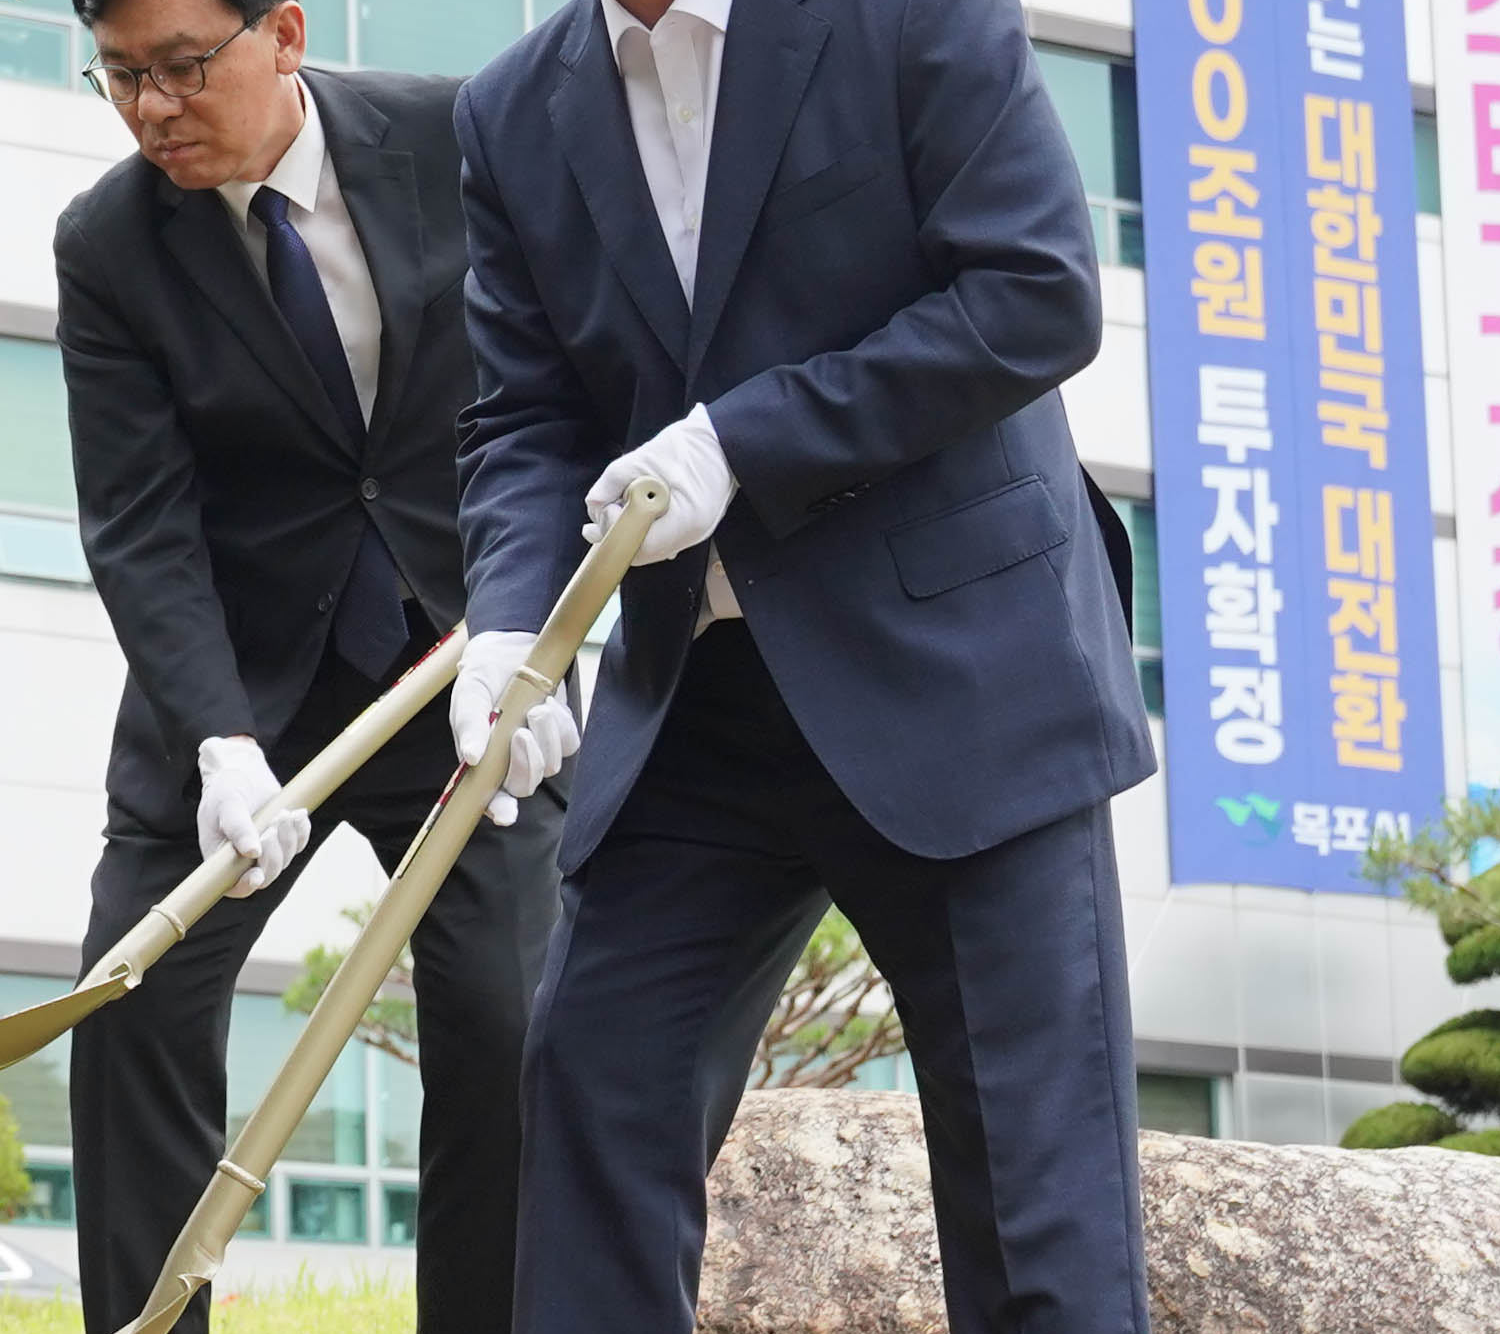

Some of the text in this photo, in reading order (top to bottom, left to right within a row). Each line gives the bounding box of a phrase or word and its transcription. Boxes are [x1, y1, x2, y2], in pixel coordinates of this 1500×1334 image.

[1303, 92, 1389, 470] 대한민국
[1196, 364, 1285, 766] 투자확정
[1322, 485, 1405, 773] 대전환
[1292, 801, 1411, 856] 목포시
